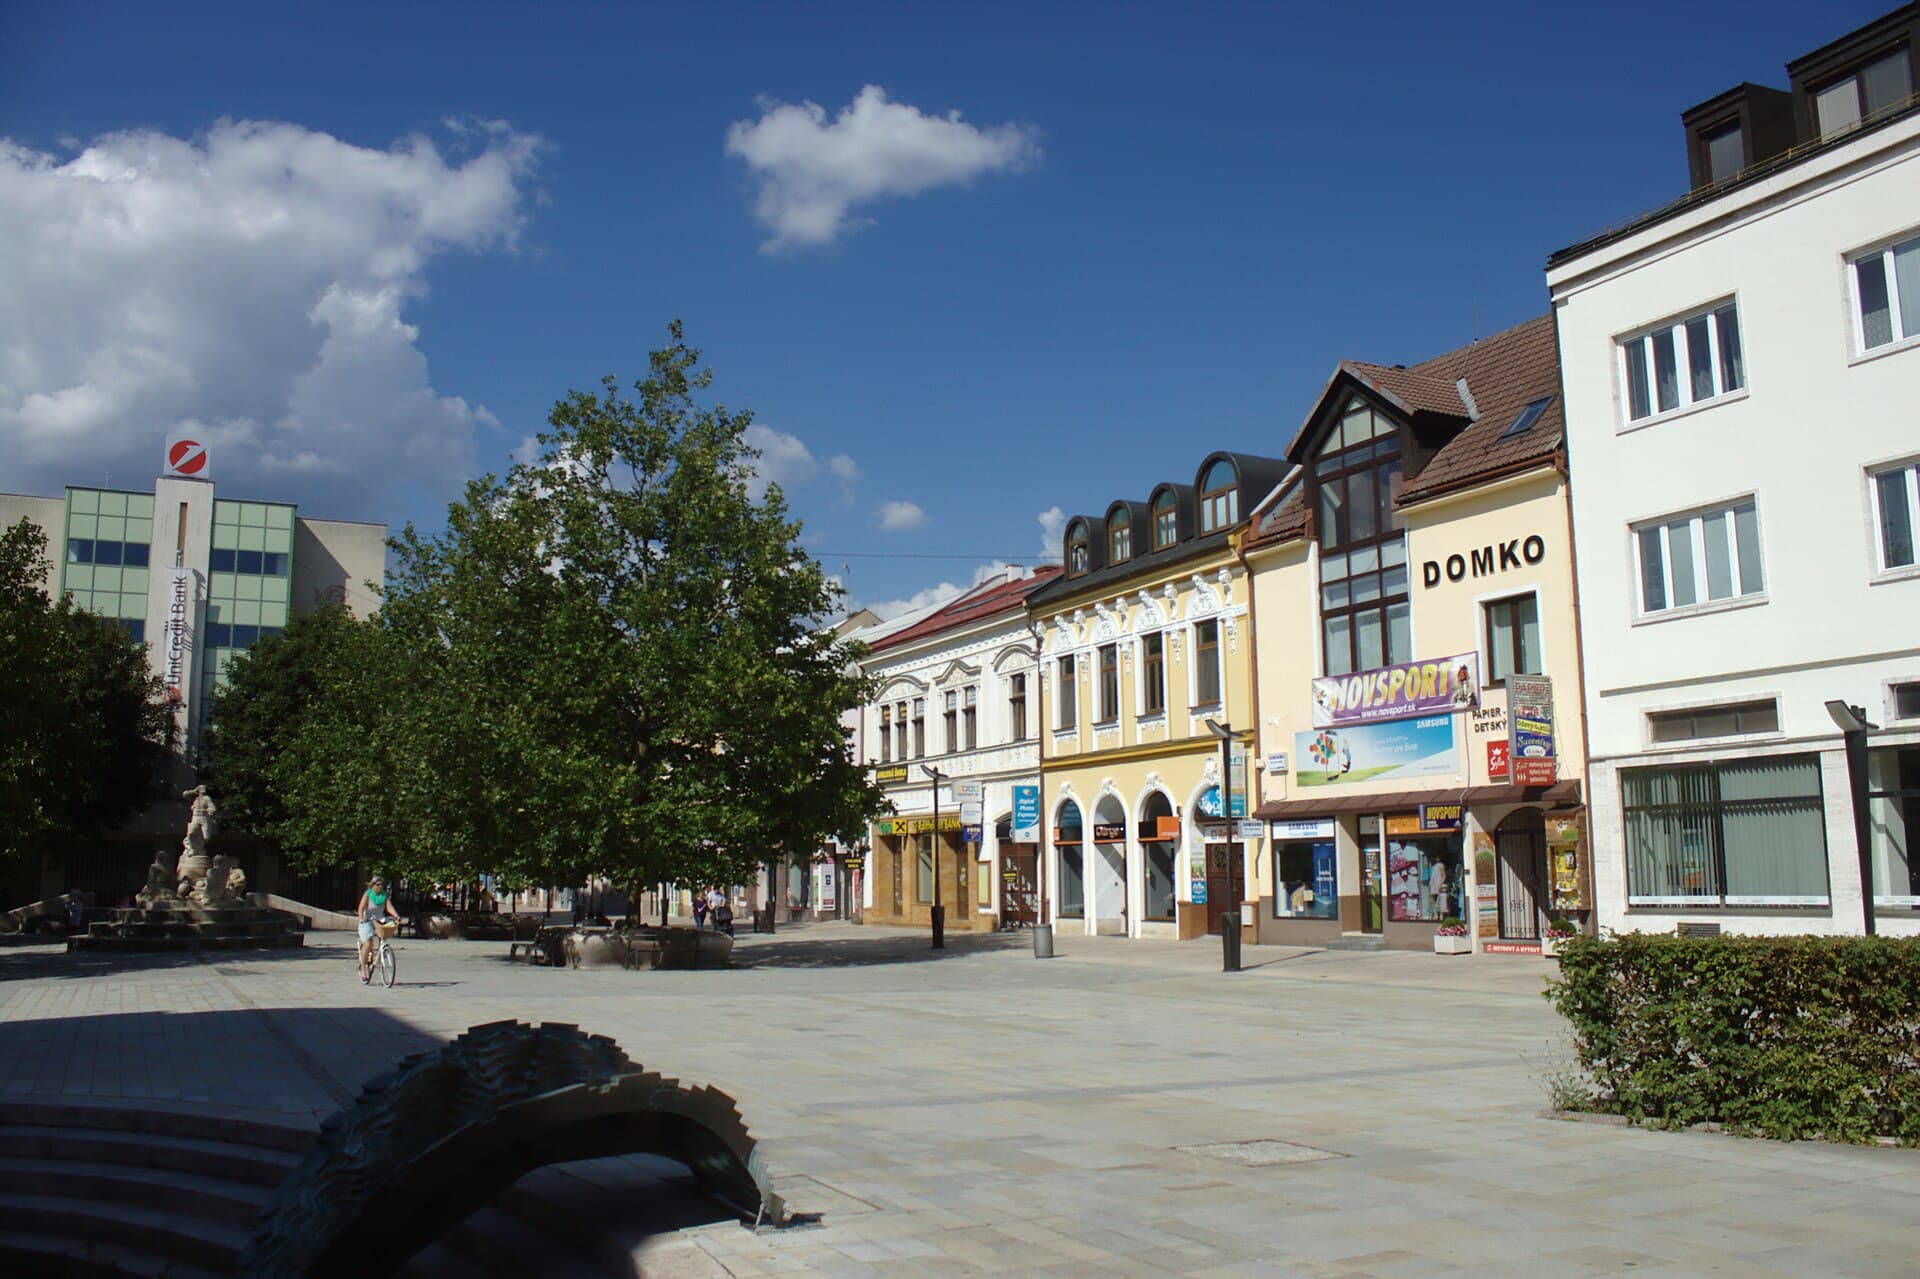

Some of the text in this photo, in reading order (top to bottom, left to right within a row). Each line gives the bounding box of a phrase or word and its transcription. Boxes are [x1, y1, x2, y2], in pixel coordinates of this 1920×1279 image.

[1423, 535, 1545, 589] DOMKO
[167, 576, 187, 685] UniCredit Bank
[1331, 661, 1452, 711] NOVSPORT
[1361, 703, 1417, 719] www.novsport.sk
[1472, 707, 1502, 720] PAPIER
[1417, 717, 1449, 729] SAMSUNG
[1474, 717, 1507, 733] DETSKÝ
[1427, 805, 1461, 820] NOVSPORT
[1288, 821, 1319, 831] SAMSUNG
